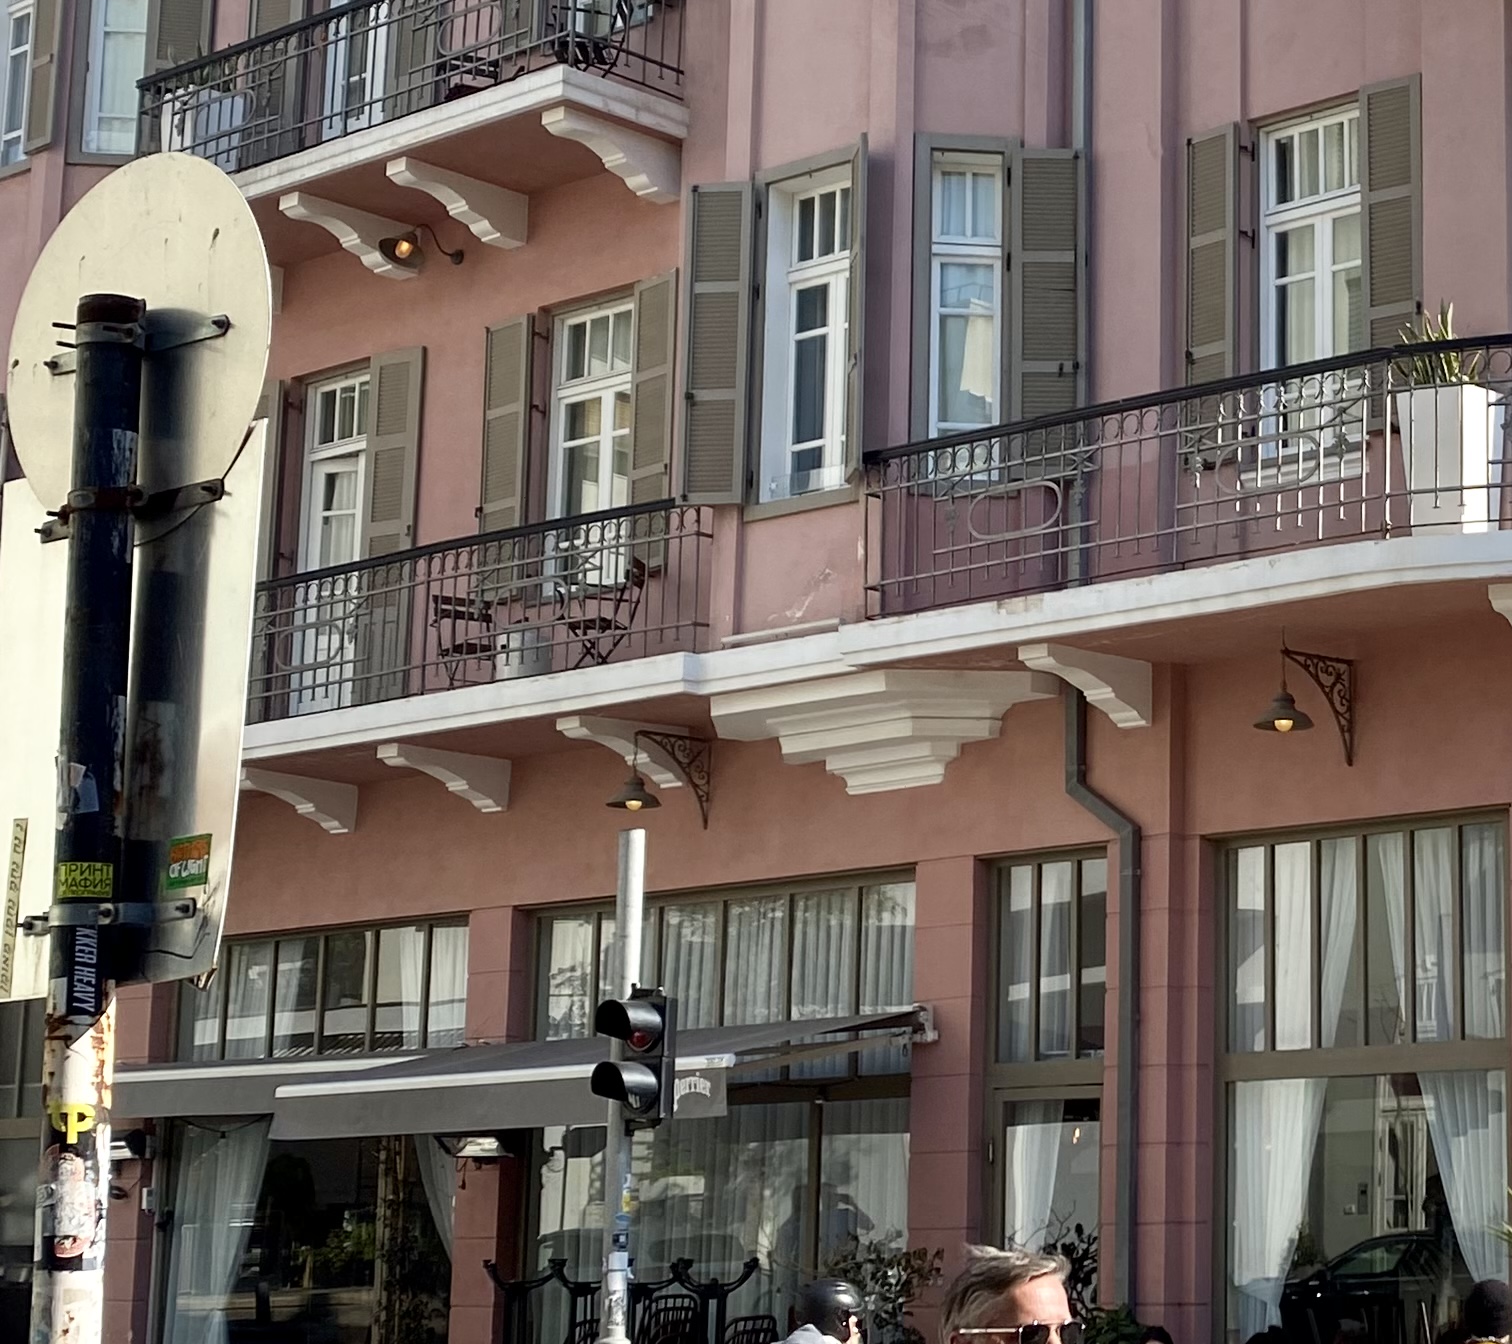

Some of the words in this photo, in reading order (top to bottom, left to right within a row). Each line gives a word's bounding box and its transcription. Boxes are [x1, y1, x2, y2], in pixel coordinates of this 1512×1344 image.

[59, 877, 111, 890] МАФИЯ
[60, 863, 111, 877] ПРИНТ
[75, 924, 98, 964] KKER
[72, 966, 96, 1012] HEAVY
